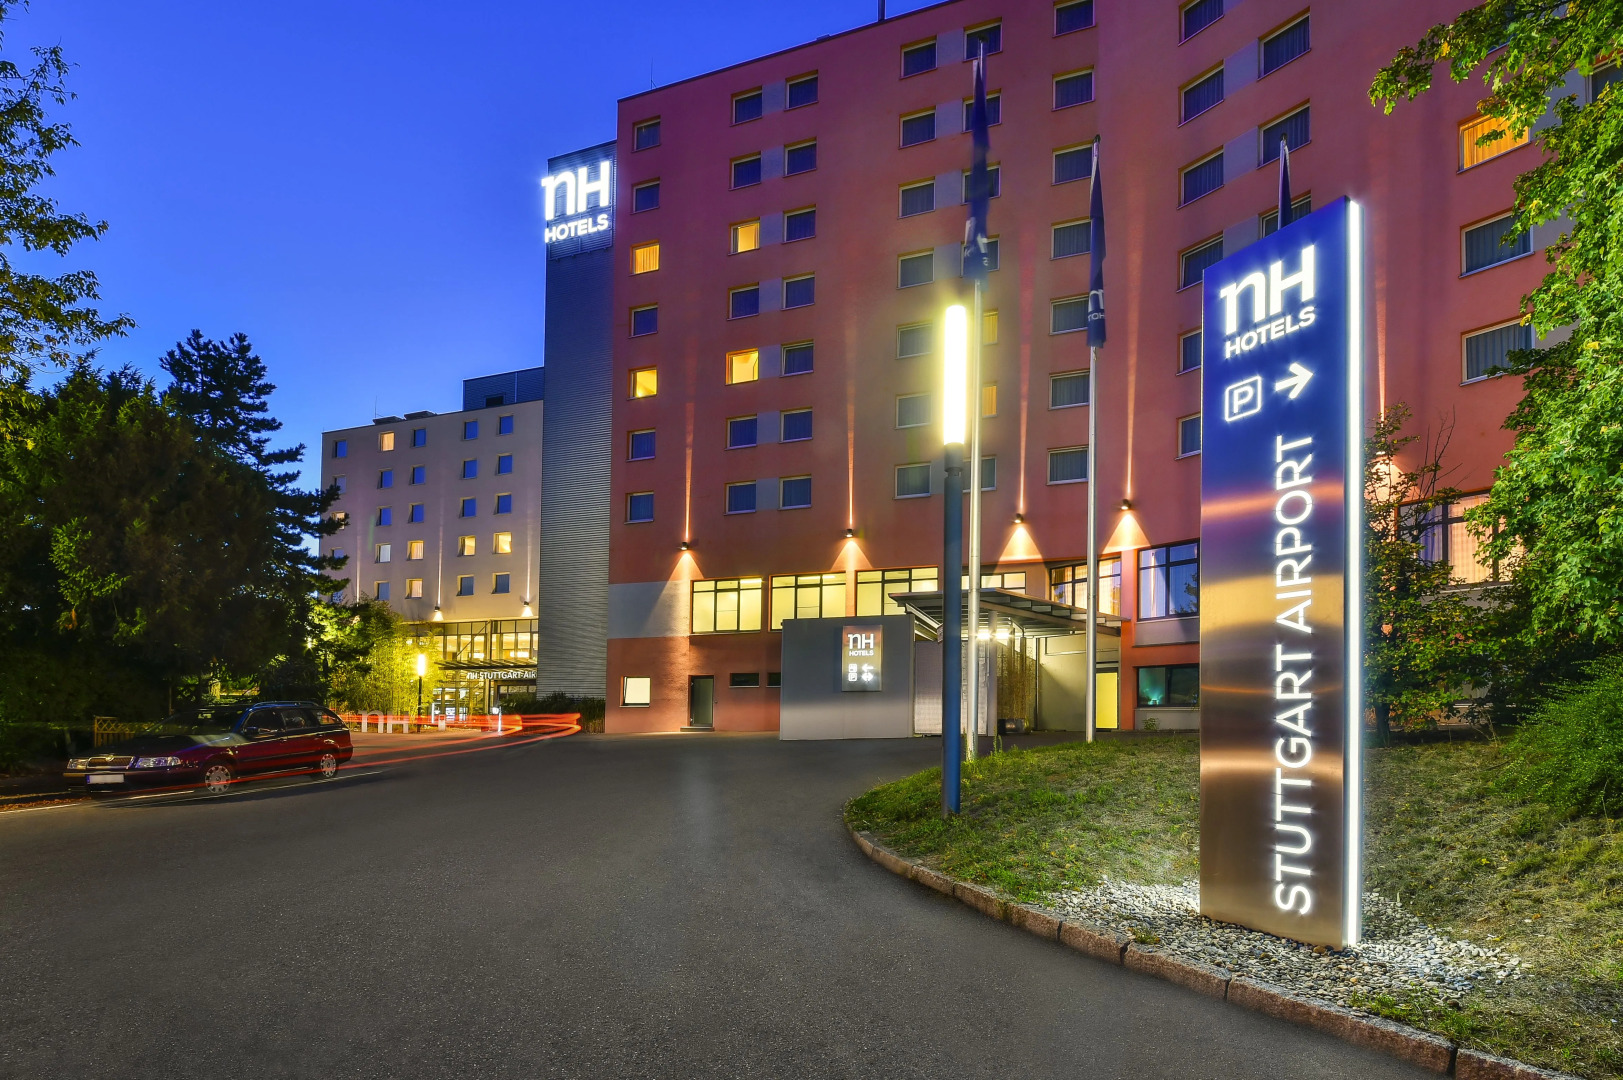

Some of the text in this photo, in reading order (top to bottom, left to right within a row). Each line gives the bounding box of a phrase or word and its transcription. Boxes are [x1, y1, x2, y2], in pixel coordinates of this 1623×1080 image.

[545, 213, 609, 243] HOTELS
[1225, 306, 1316, 359] HOTELS
[1233, 385, 1254, 414] P
[479, 671, 521, 679] STUTTGART
[1275, 435, 1313, 914] STUTTGART AIRPORT
